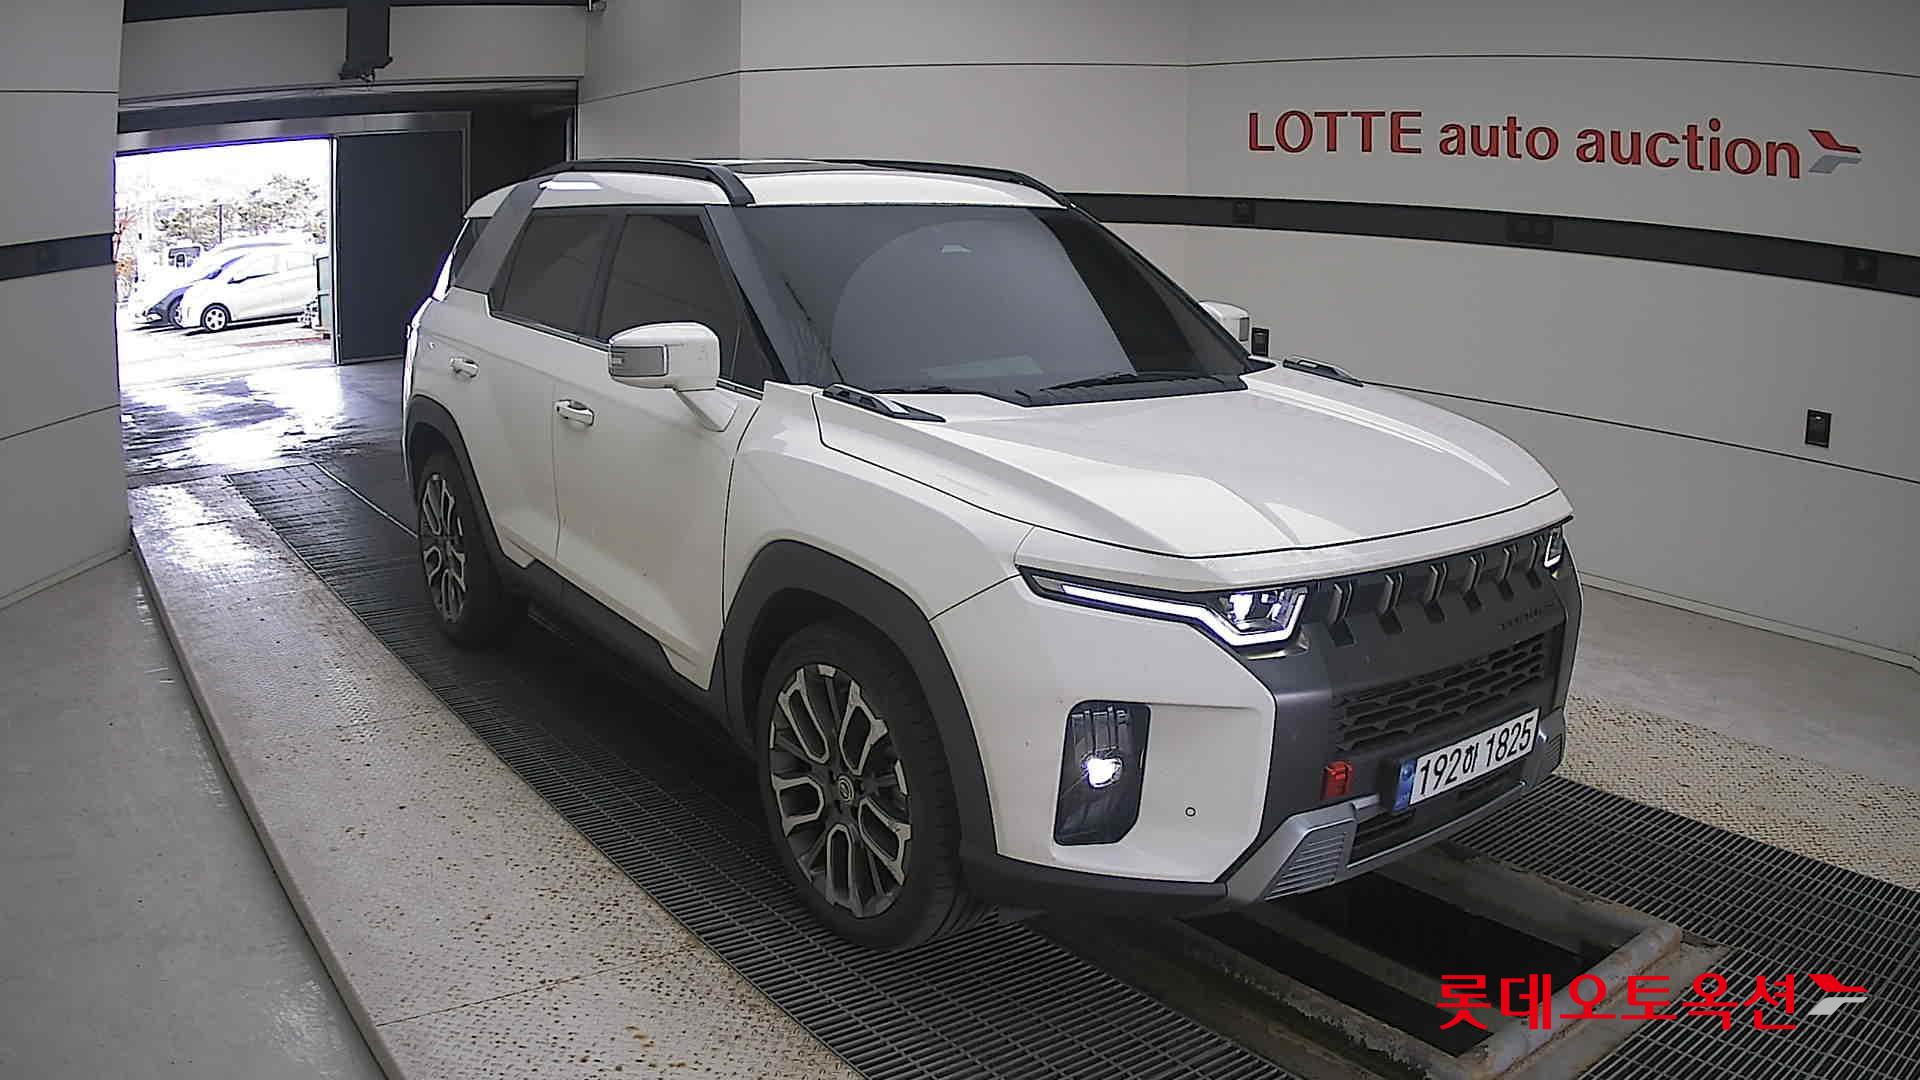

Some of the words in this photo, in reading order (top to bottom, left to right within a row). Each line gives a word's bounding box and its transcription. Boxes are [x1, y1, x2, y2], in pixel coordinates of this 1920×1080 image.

[1249, 111, 1422, 154] LOTTE
[1439, 116, 1559, 161] auto
[1576, 118, 1800, 179] auction
[1486, 718, 1533, 767] 1825
